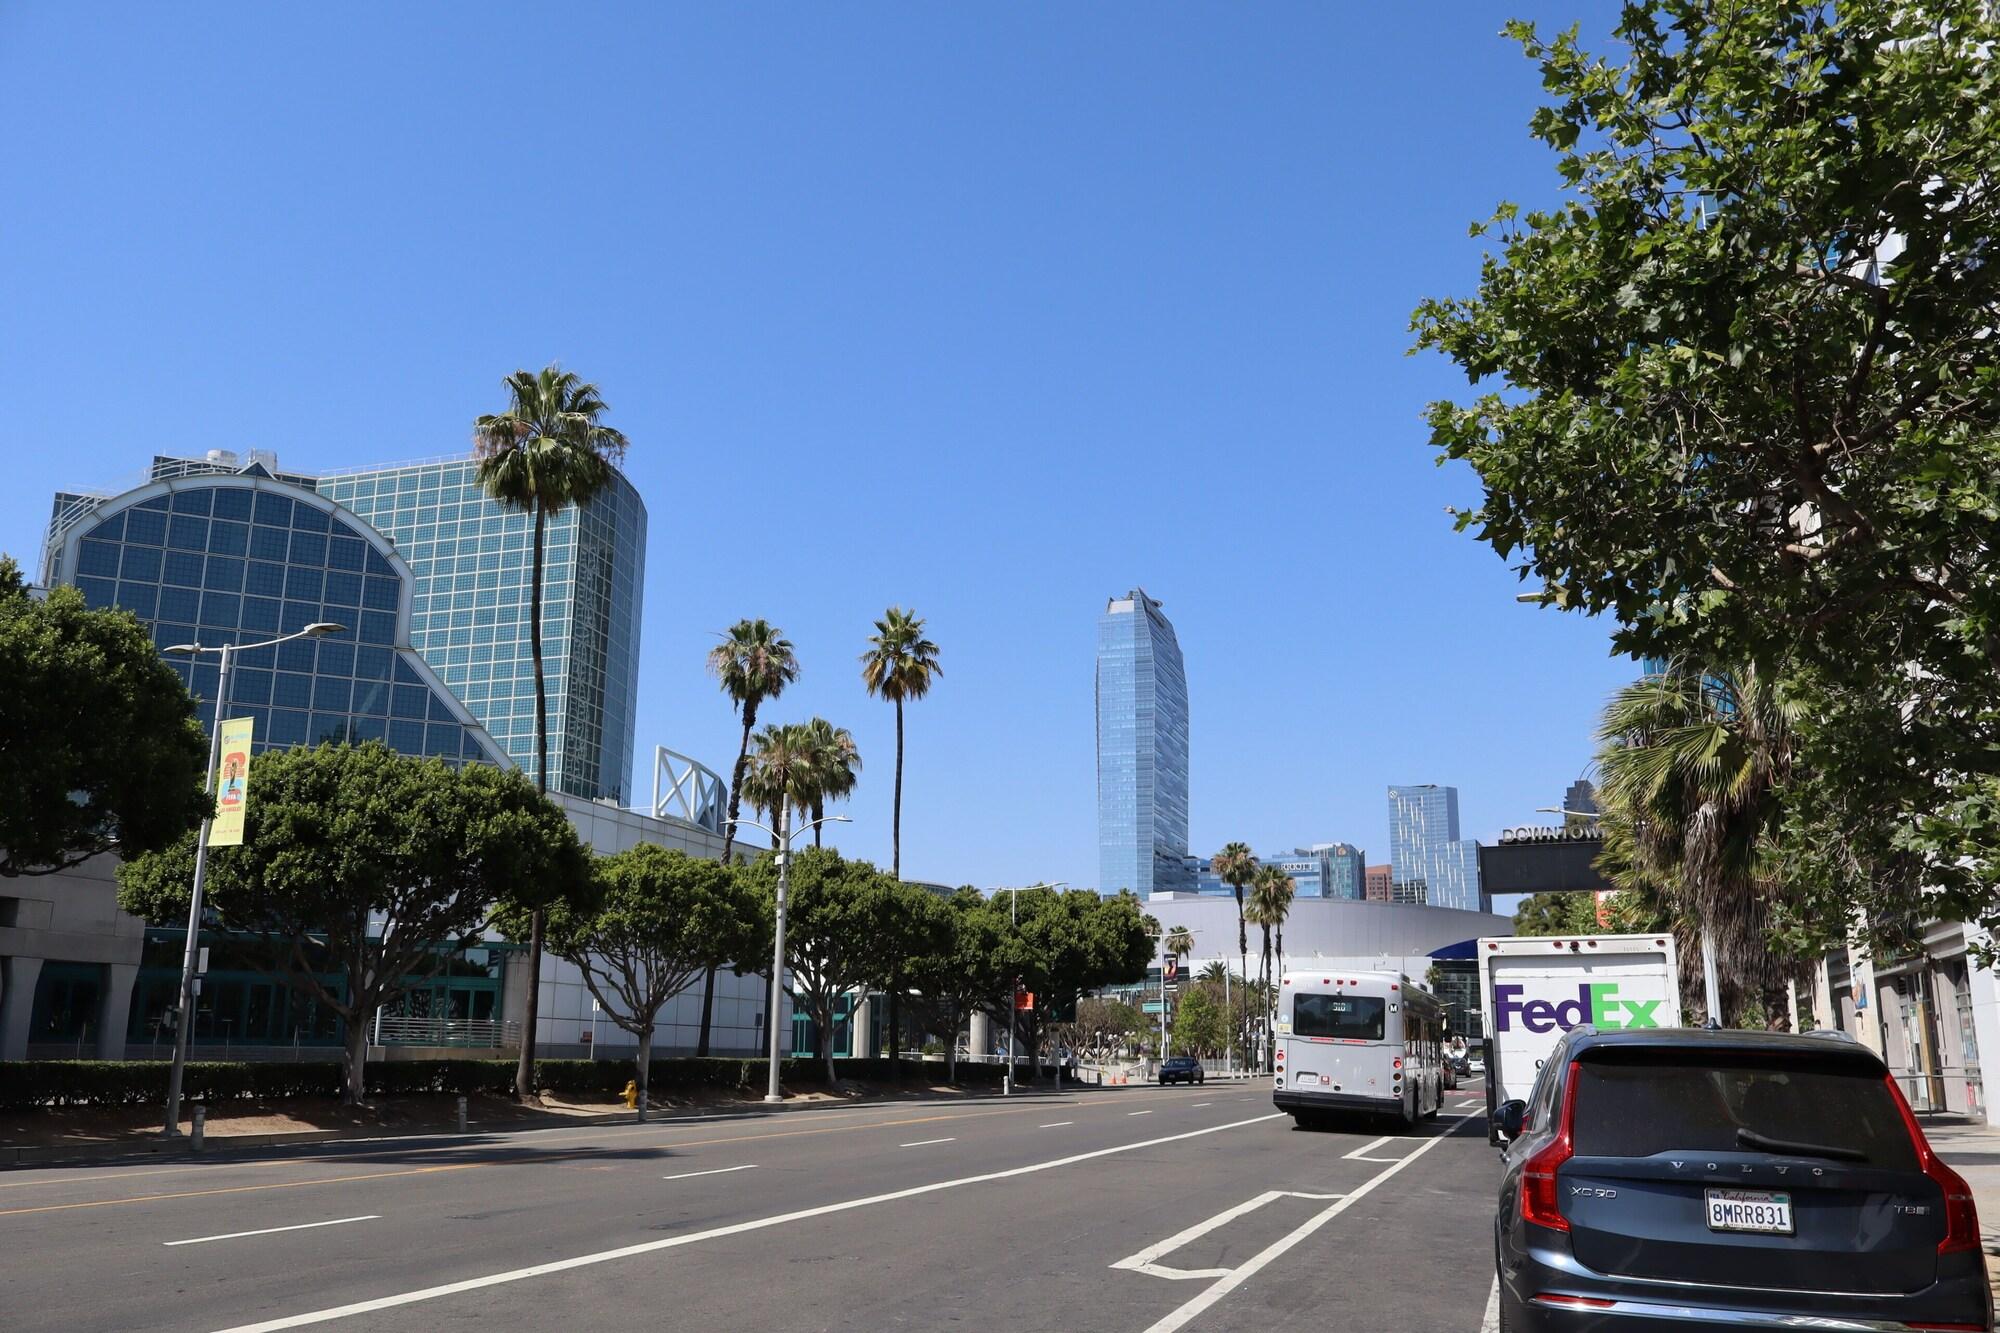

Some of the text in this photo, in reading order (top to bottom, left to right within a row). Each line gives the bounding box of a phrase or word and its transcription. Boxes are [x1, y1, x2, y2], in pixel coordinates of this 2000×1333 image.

[1280, 862, 1312, 871] RRIOTT
[1494, 983, 1661, 1033] FedEx
[1670, 1161, 1823, 1176] VOLVO
[1713, 1203, 1786, 1226] 8MRR831
